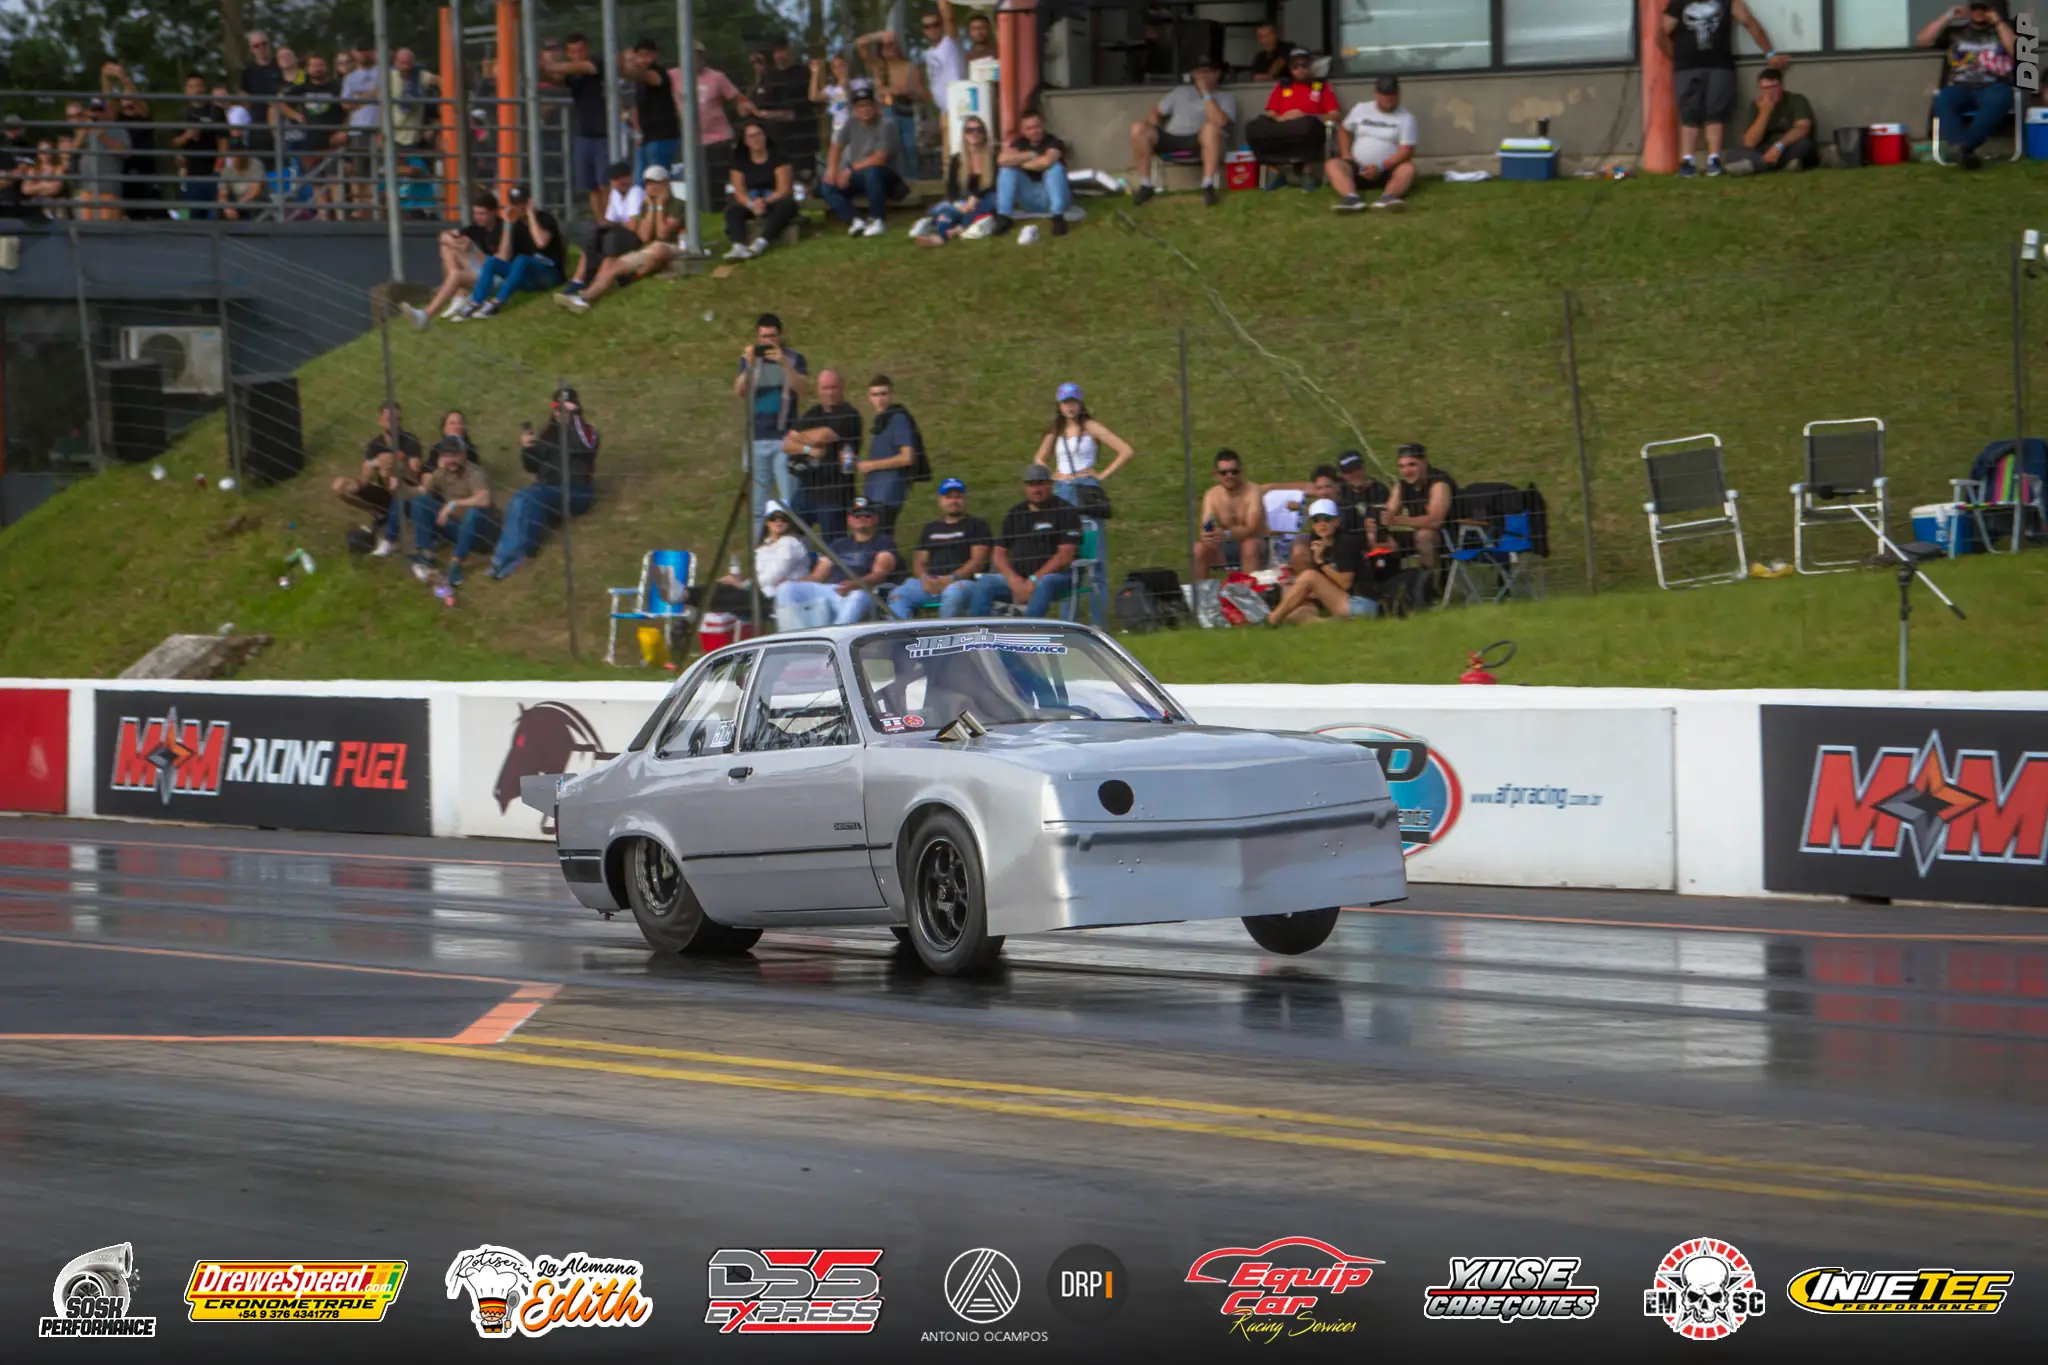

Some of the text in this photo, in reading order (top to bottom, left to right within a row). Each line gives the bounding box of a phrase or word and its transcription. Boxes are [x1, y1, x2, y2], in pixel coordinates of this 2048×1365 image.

[964, 642, 1067, 654] PERFORMANCE
[225, 737, 335, 786] RACING
[334, 741, 409, 790] FUEL
